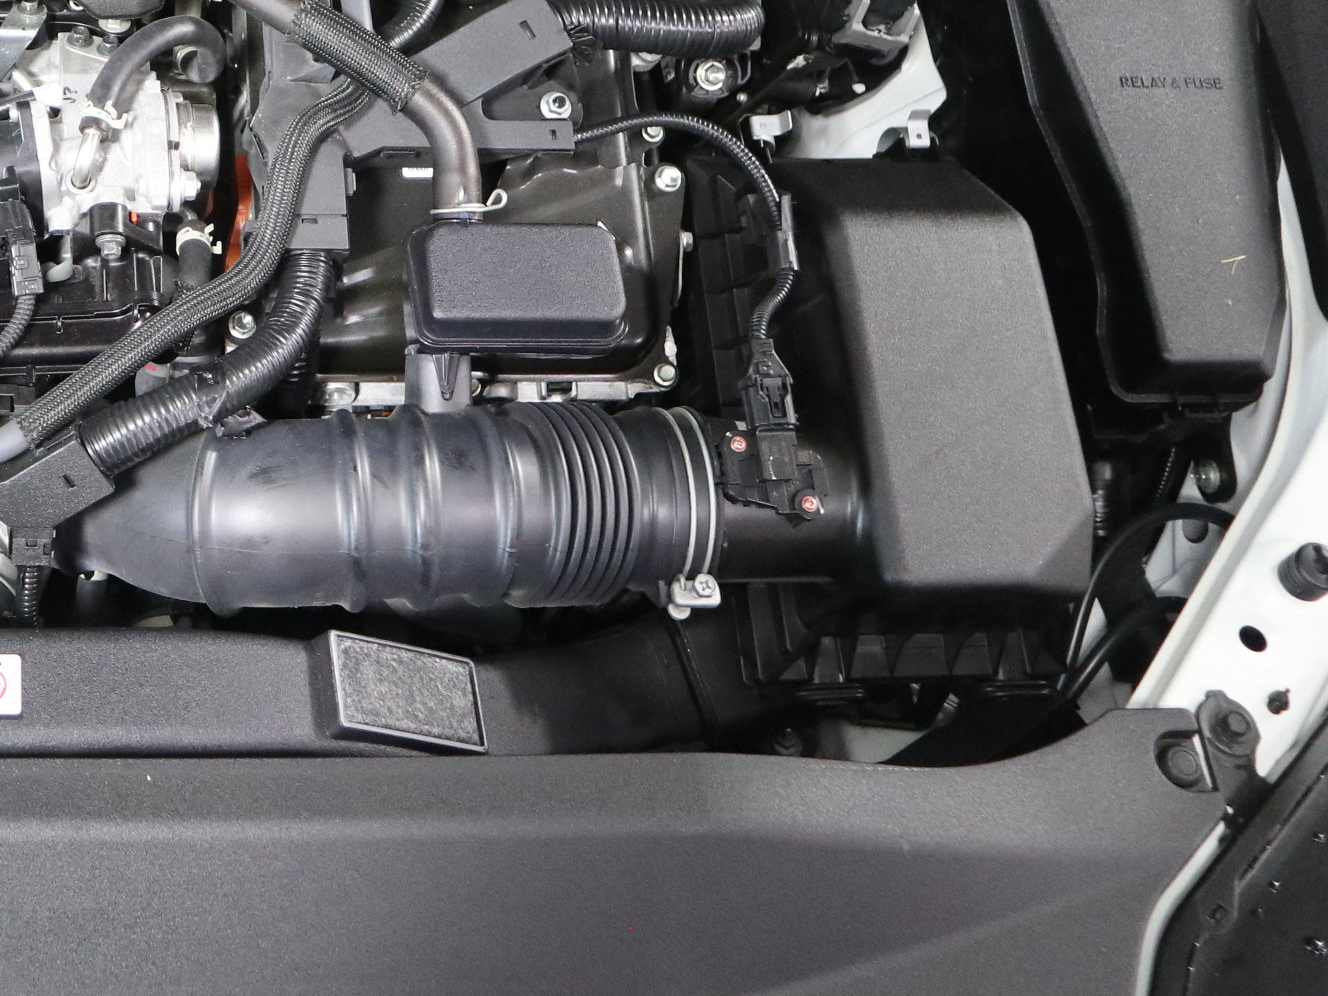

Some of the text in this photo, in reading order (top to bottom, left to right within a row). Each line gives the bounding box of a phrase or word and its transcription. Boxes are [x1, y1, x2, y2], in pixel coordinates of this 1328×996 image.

[1119, 75, 1223, 90] RELAY & FUSE
